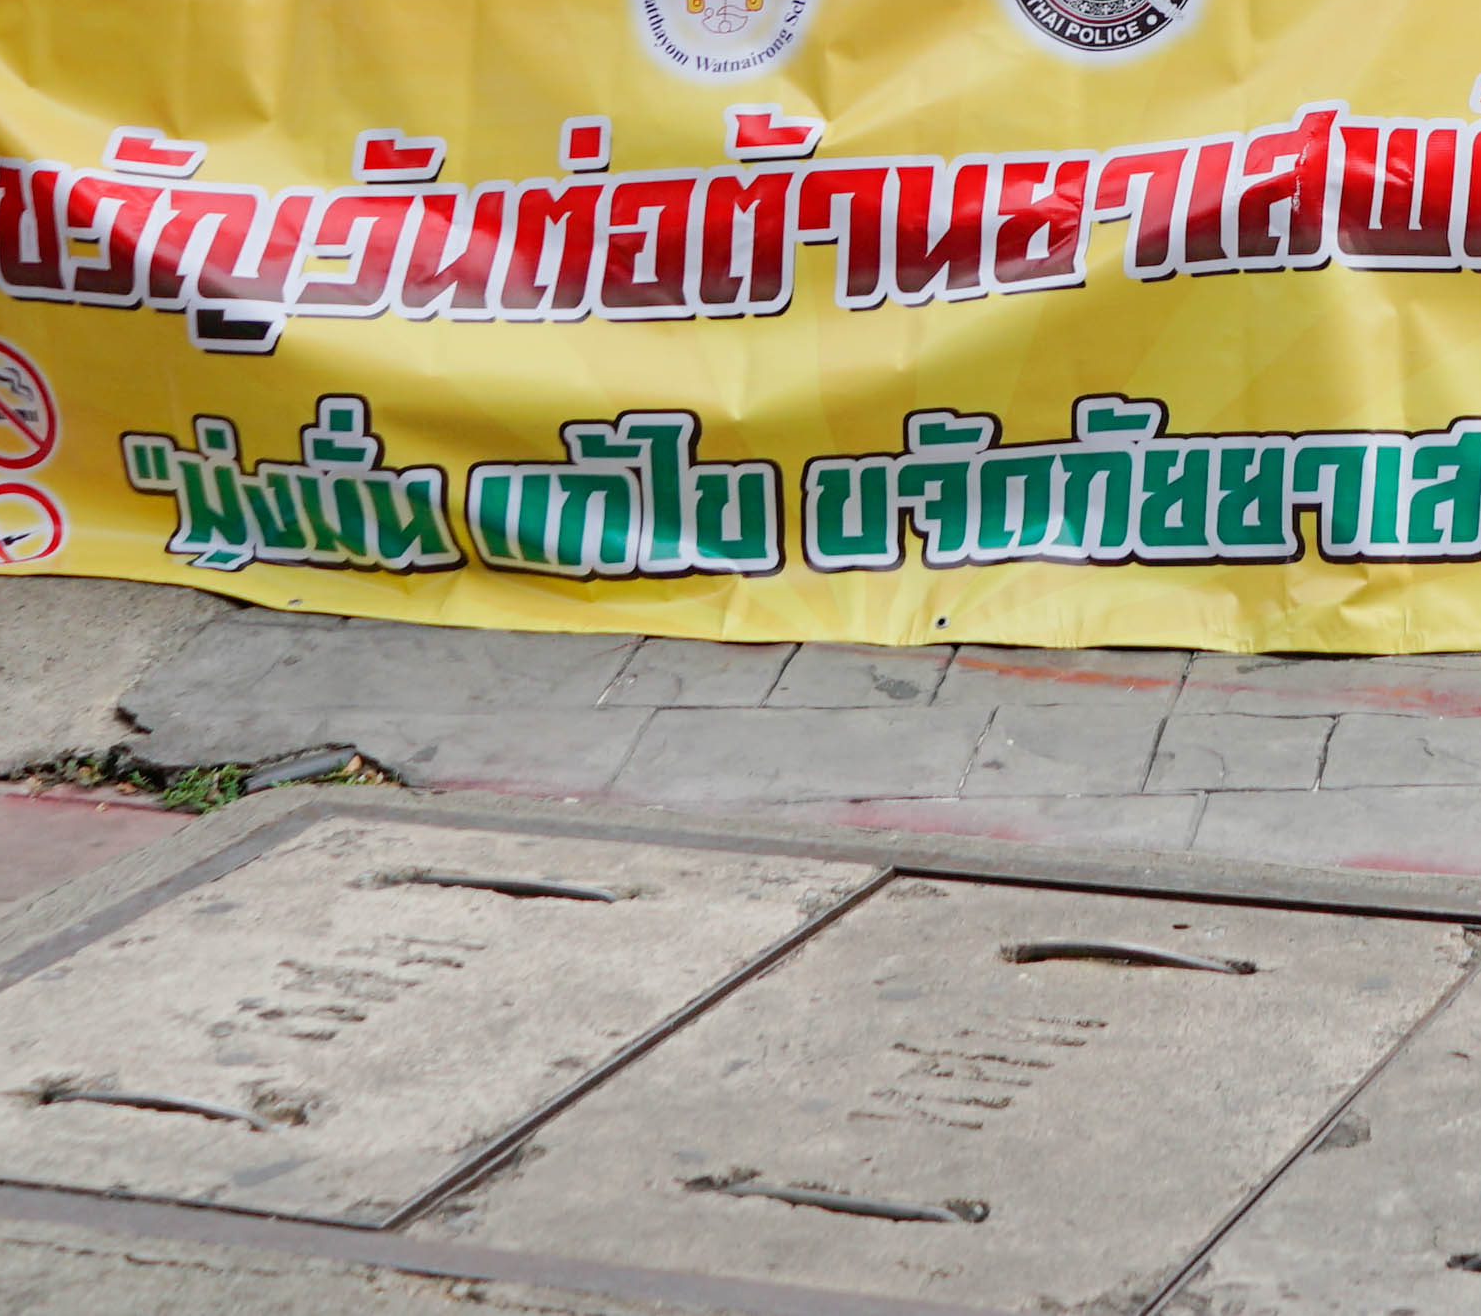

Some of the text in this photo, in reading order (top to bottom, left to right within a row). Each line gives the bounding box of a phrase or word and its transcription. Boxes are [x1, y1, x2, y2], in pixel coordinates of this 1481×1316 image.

[696, 28, 794, 73] Watnairong
[1064, 20, 1142, 45] POLICE
[473, 423, 769, 565] แก้ไข
